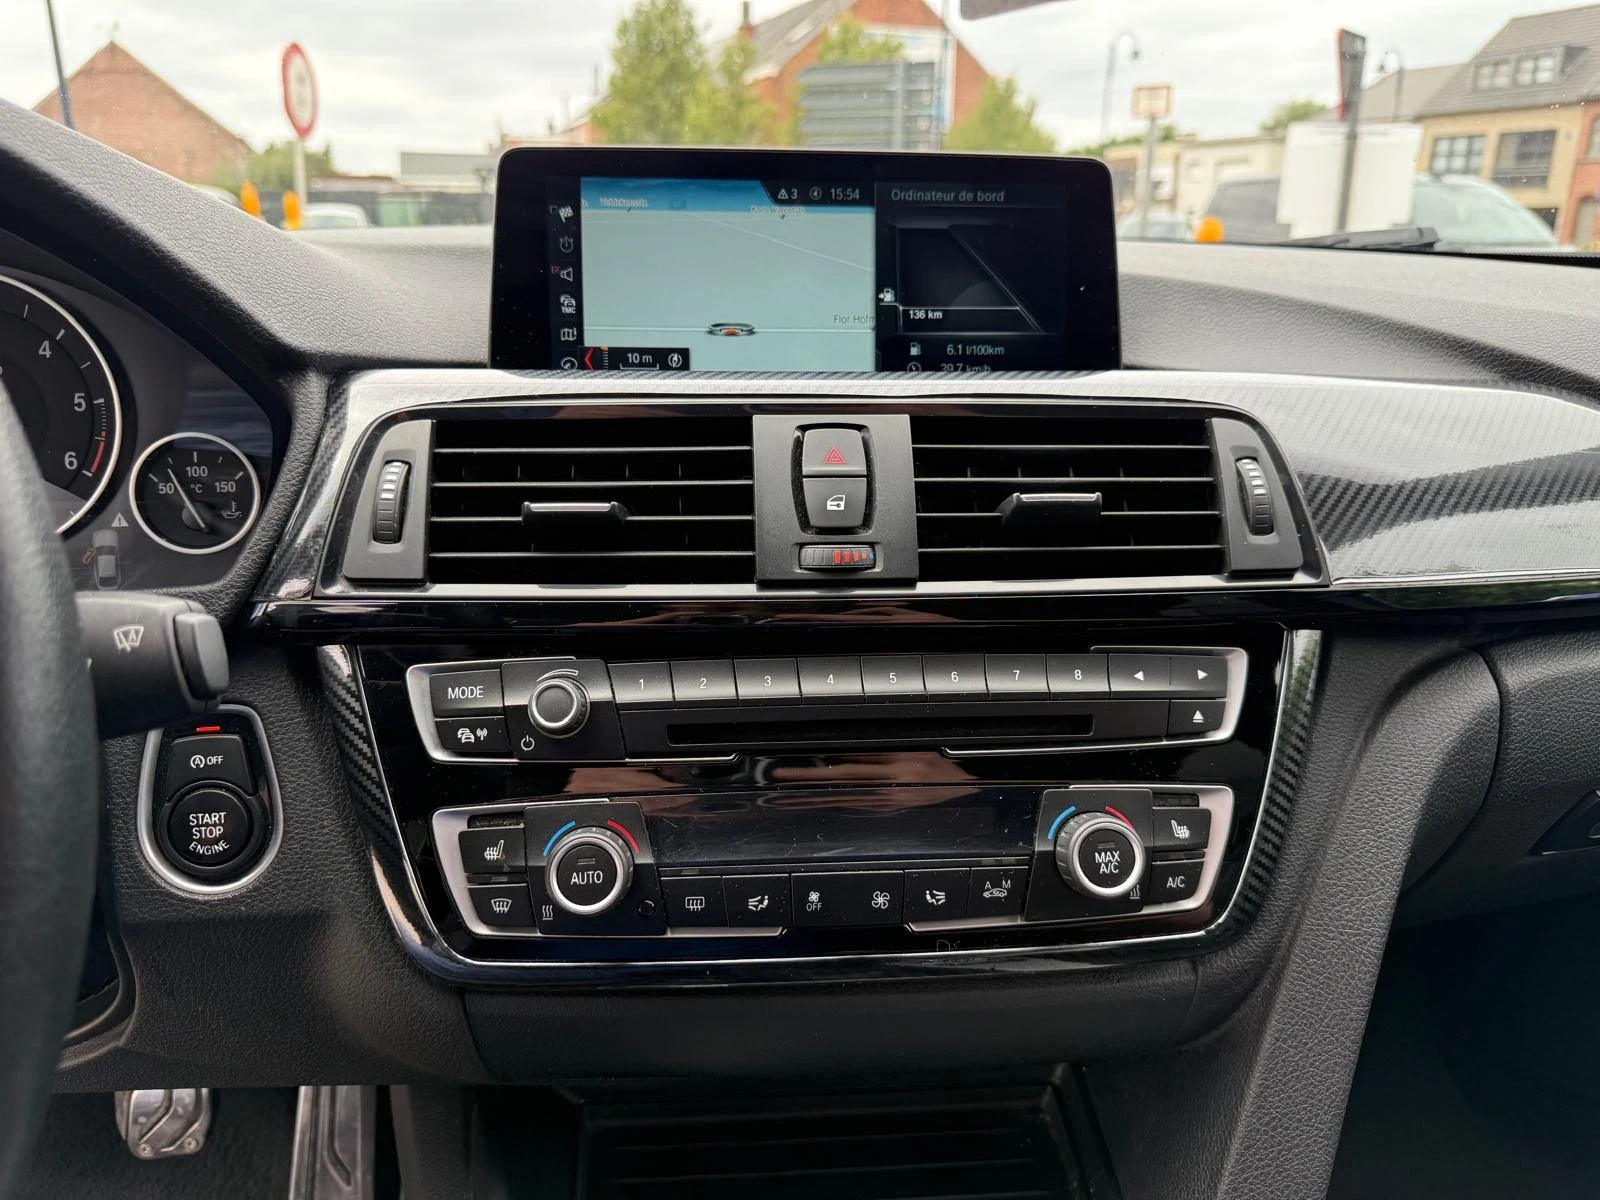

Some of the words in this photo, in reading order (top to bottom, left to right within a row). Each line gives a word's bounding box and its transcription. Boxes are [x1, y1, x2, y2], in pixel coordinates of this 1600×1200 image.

[791, 188, 798, 200] 3
[830, 187, 860, 201] 15:54
[891, 188, 955, 202] Ordinateur
[958, 190, 973, 202] de
[977, 189, 1005, 203] bord
[561, 305, 576, 314] TMC
[908, 309, 926, 320] 136
[928, 310, 943, 320] km
[833, 314, 850, 325] Flor
[38, 340, 52, 359] 4
[946, 343, 963, 356] 6.1
[627, 352, 640, 364] 10
[642, 355, 653, 363] m
[73, 393, 86, 412] 5
[64, 452, 78, 470] 6
[185, 466, 208, 478] 100
[158, 483, 175, 494] 50
[190, 483, 203, 493] °C
[214, 481, 236, 493] 150
[763, 675, 772, 688] 3
[826, 674, 836, 686] 4
[889, 672, 898, 685] 5
[950, 671, 960, 684] 6
[1012, 669, 1021, 682] 7
[1074, 669, 1083, 681] 8
[638, 678, 645, 690] 1
[699, 678, 708, 690] 2
[447, 685, 484, 700] MODE
[207, 756, 224, 765] OFF
[189, 812, 227, 826] START
[192, 826, 224, 839] STOP
[188, 839, 230, 855] ENGINE
[1095, 851, 1121, 864] MAX
[1099, 862, 1120, 876] A/C
[570, 869, 604, 886] AUTO
[1166, 875, 1186, 889] A/C
[984, 880, 992, 890] A
[1002, 879, 1012, 890] M
[806, 902, 823, 911] OFF
